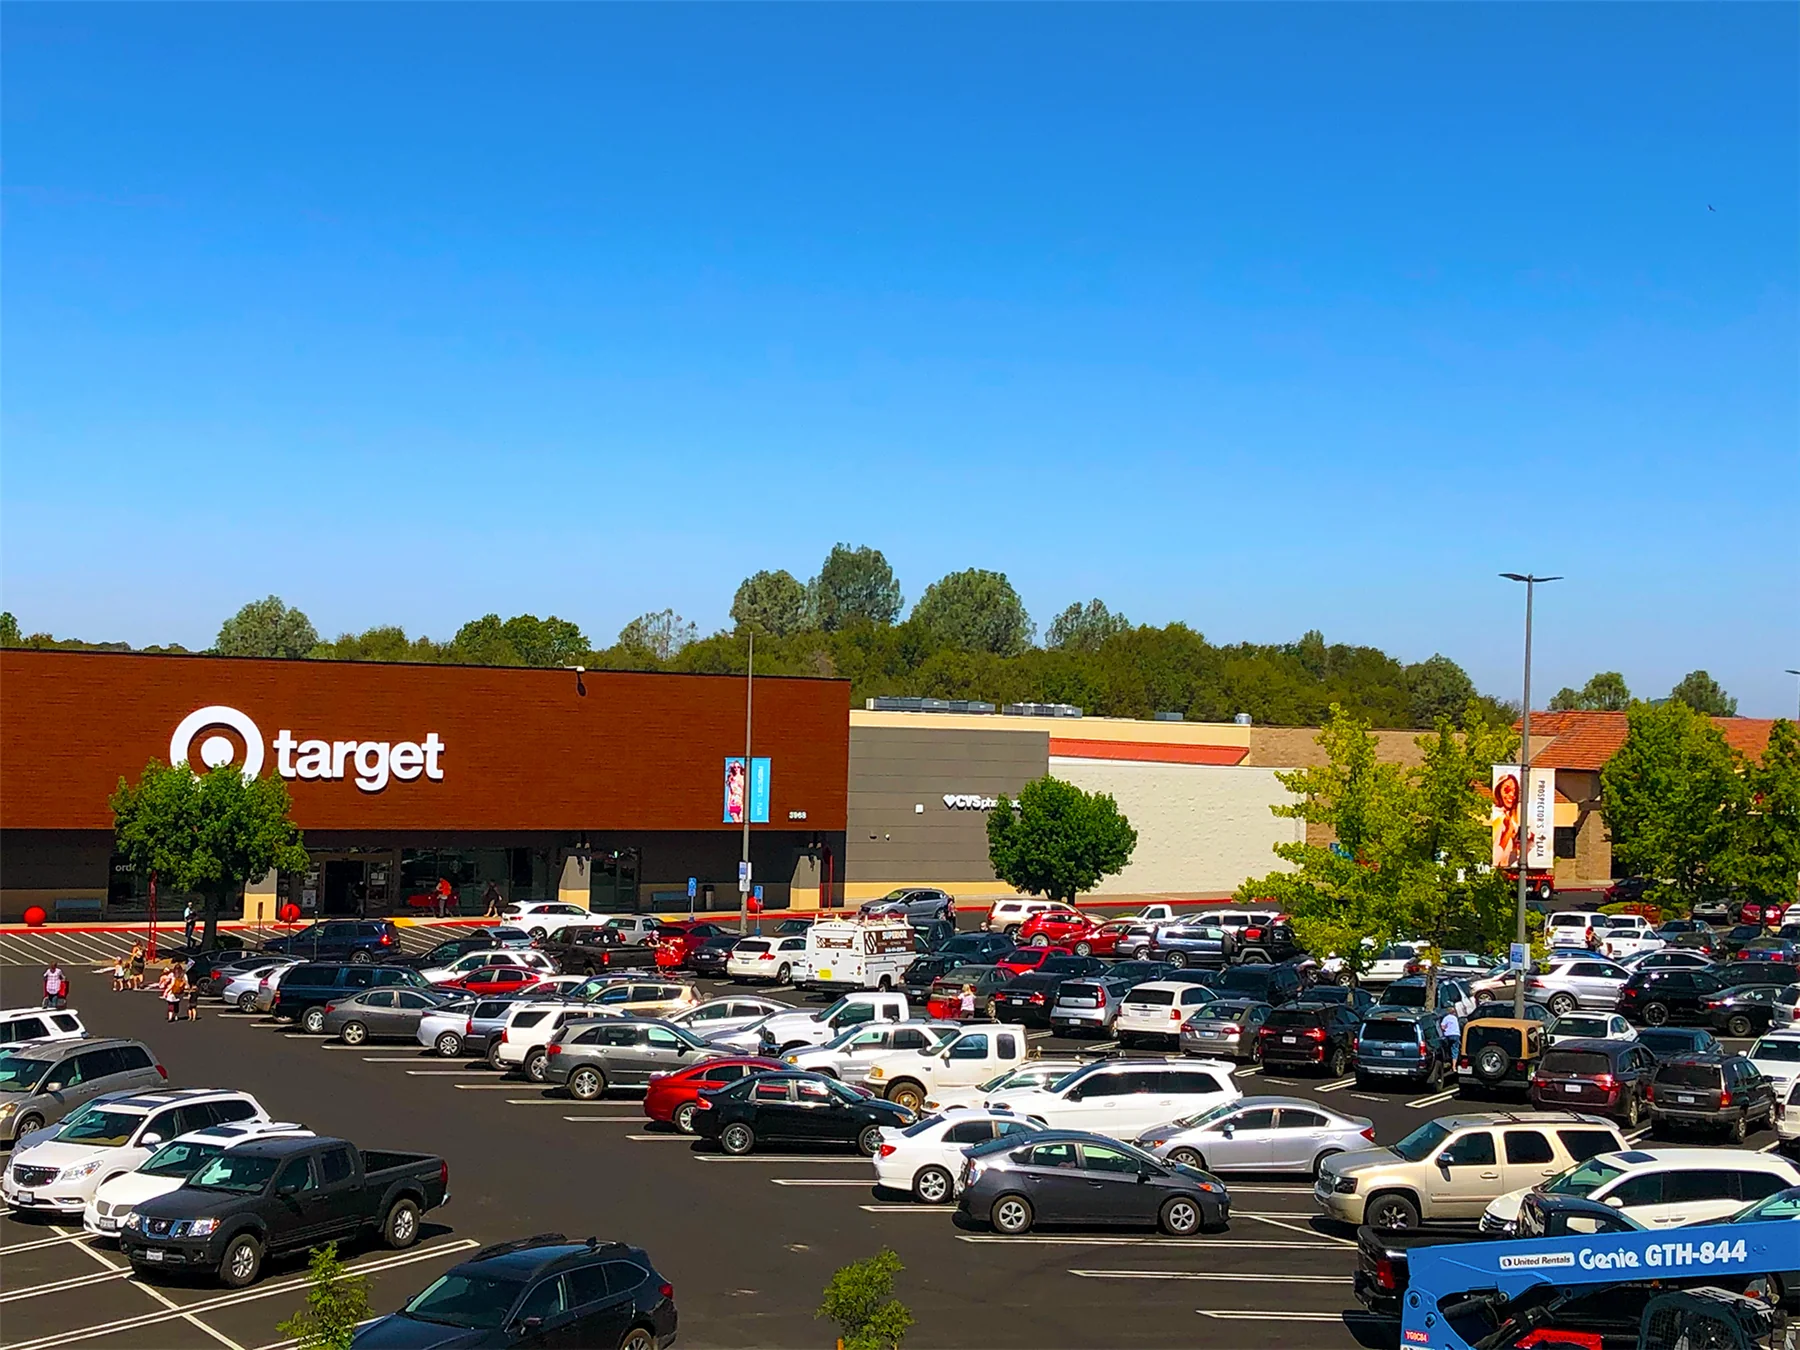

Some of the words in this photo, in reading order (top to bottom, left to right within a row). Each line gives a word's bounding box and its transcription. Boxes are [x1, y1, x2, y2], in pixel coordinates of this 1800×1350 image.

[272, 729, 445, 791] target
[955, 794, 981, 808] CVS
[1513, 1256, 1540, 1267] United
[1541, 1254, 1571, 1266] Rentals
[1578, 1247, 1640, 1271] Genie
[1645, 1239, 1747, 1267] GTH-844
